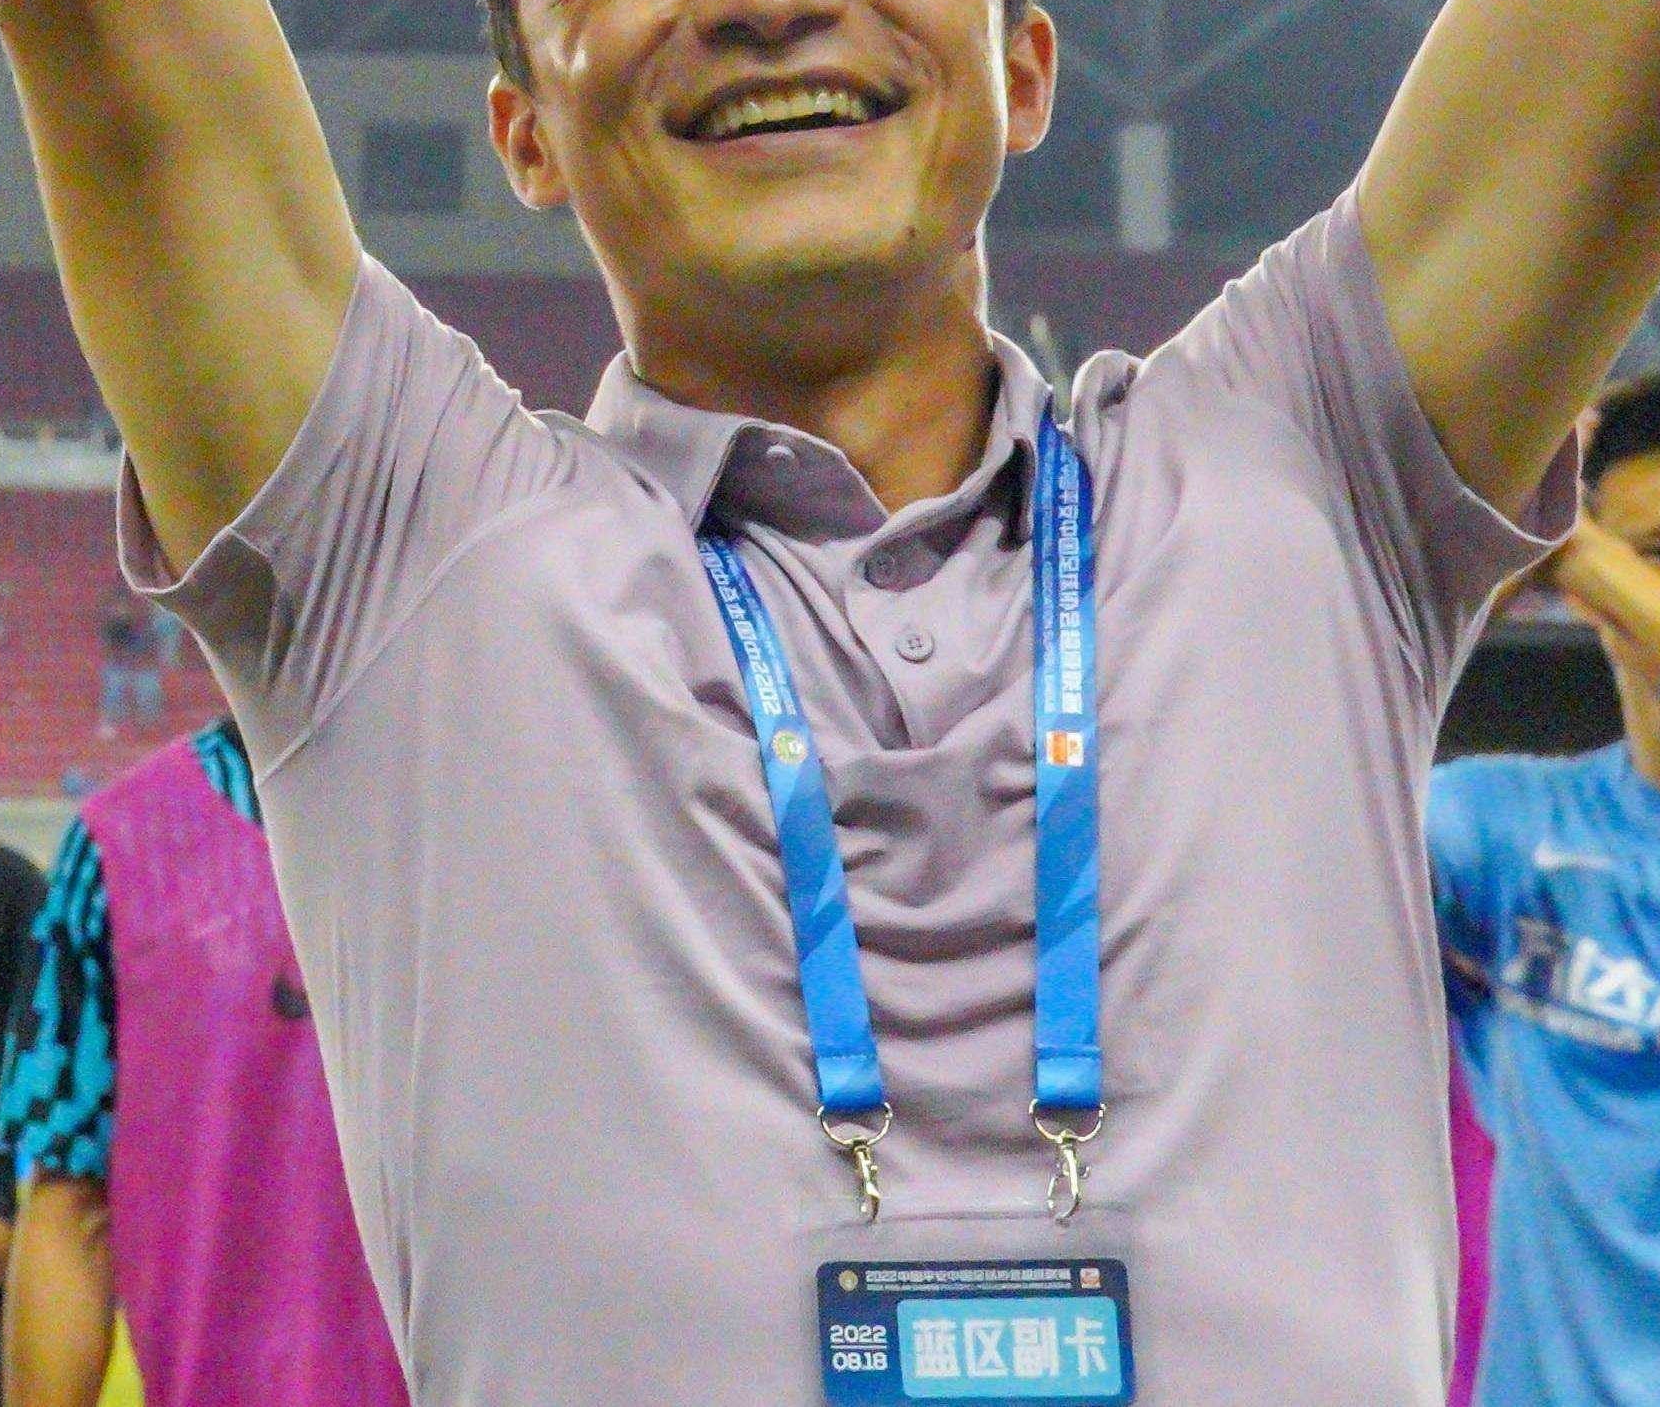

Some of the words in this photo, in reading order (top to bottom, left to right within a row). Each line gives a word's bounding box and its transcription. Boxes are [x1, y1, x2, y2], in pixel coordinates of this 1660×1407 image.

[830, 1324, 888, 1344] 2022
[912, 1317, 1107, 1378] 蓝区副卡
[832, 1351, 889, 1371] 08.18
